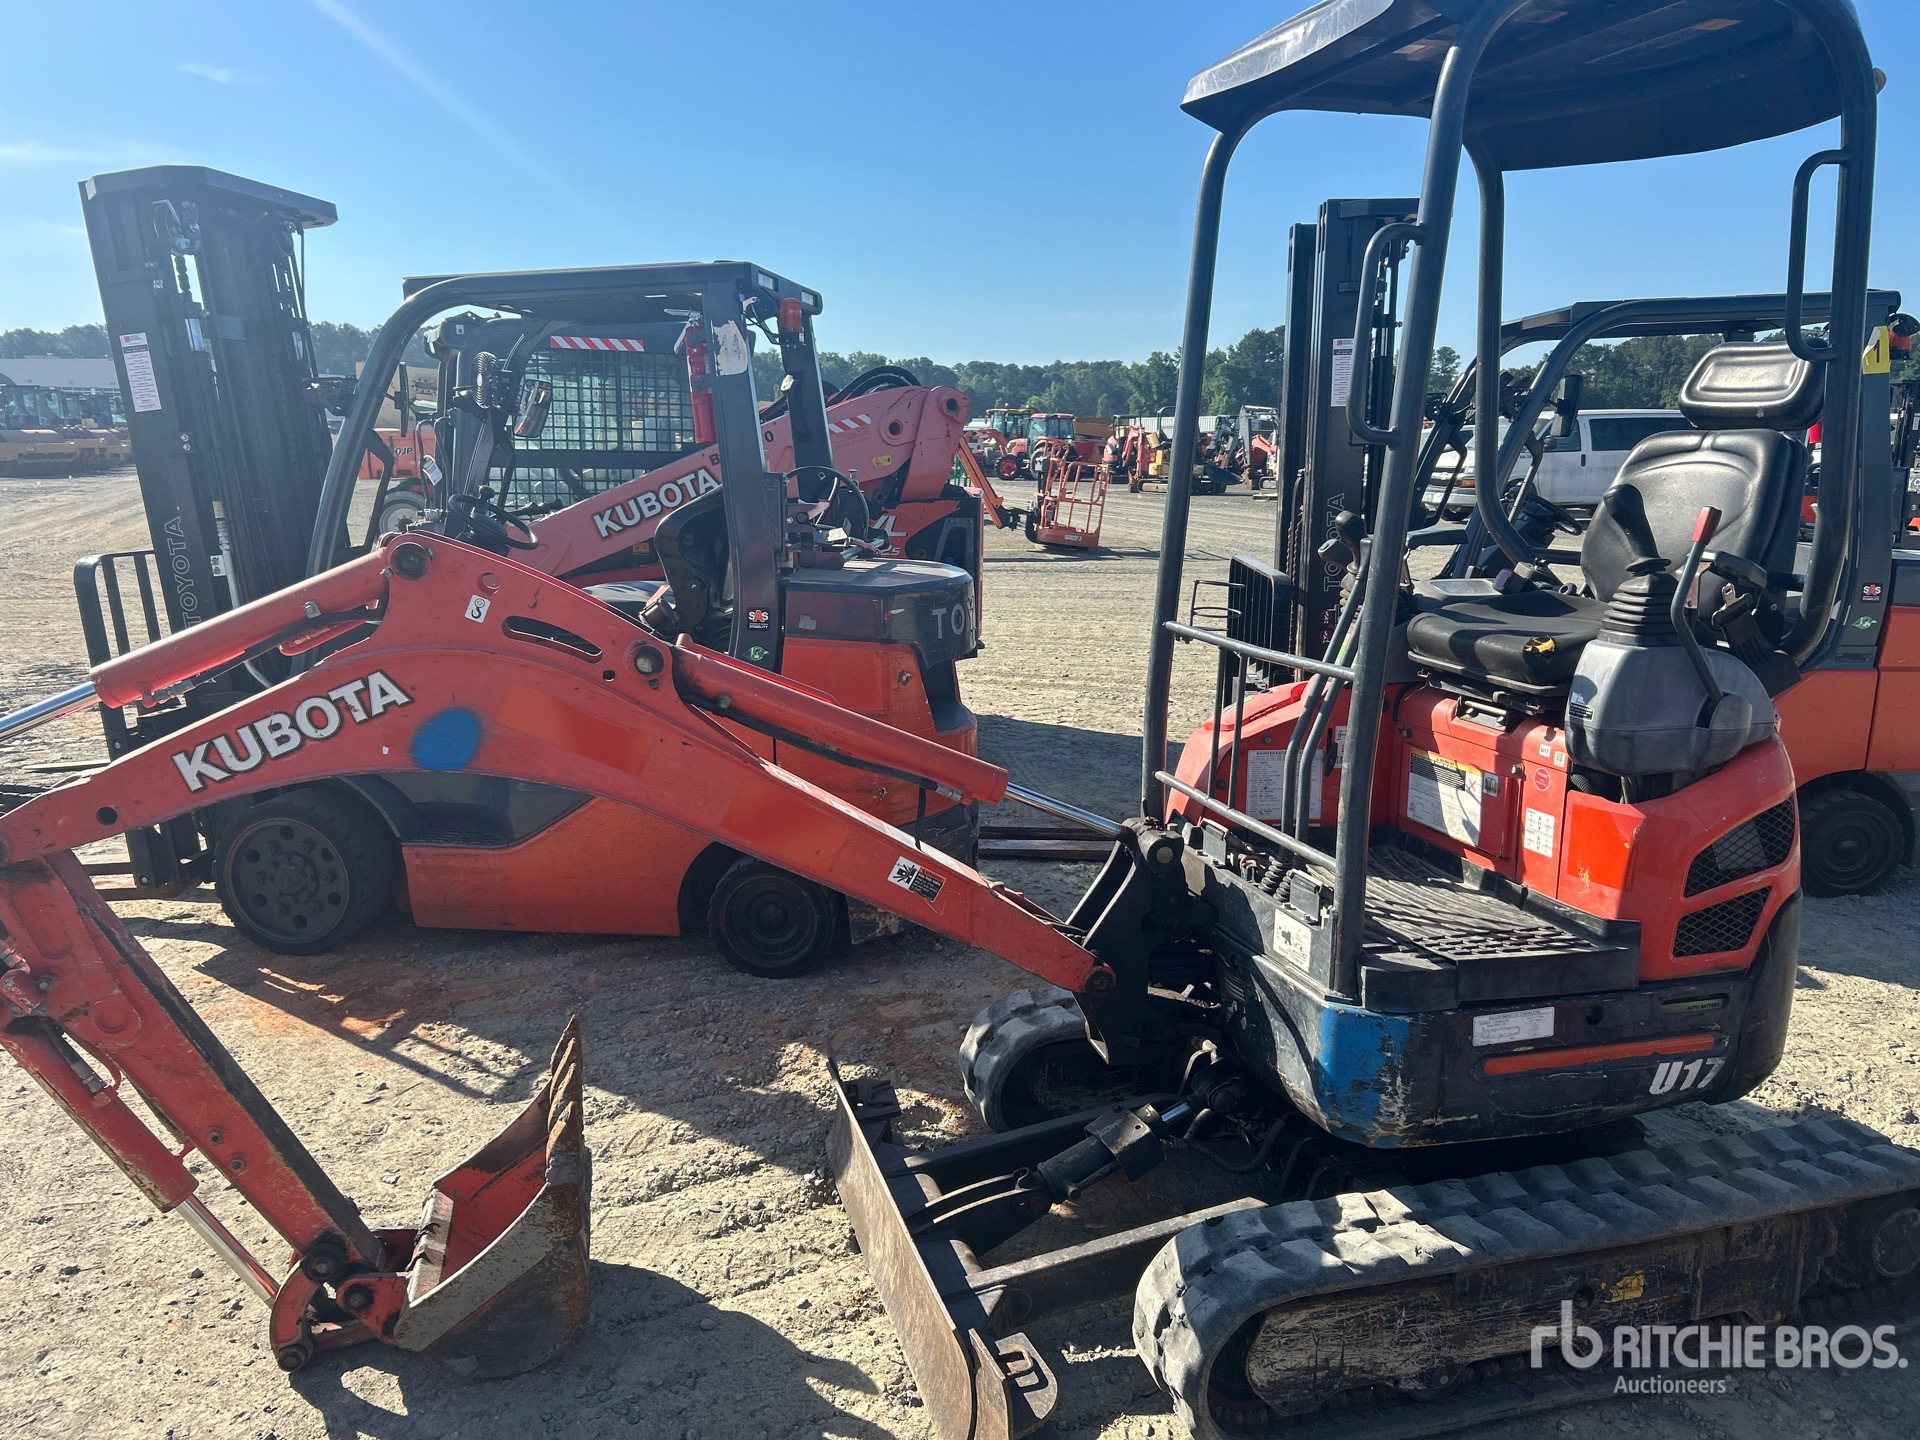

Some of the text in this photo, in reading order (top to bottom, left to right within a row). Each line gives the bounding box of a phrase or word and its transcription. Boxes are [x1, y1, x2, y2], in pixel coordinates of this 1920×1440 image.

[592, 468, 720, 538] KUBOTA
[163, 516, 202, 629] TOYOTA
[1862, 584, 1882, 596] SAS
[748, 609, 769, 622] SAS
[171, 670, 413, 793] KUBOTA
[1648, 1056, 1727, 1095] U17
